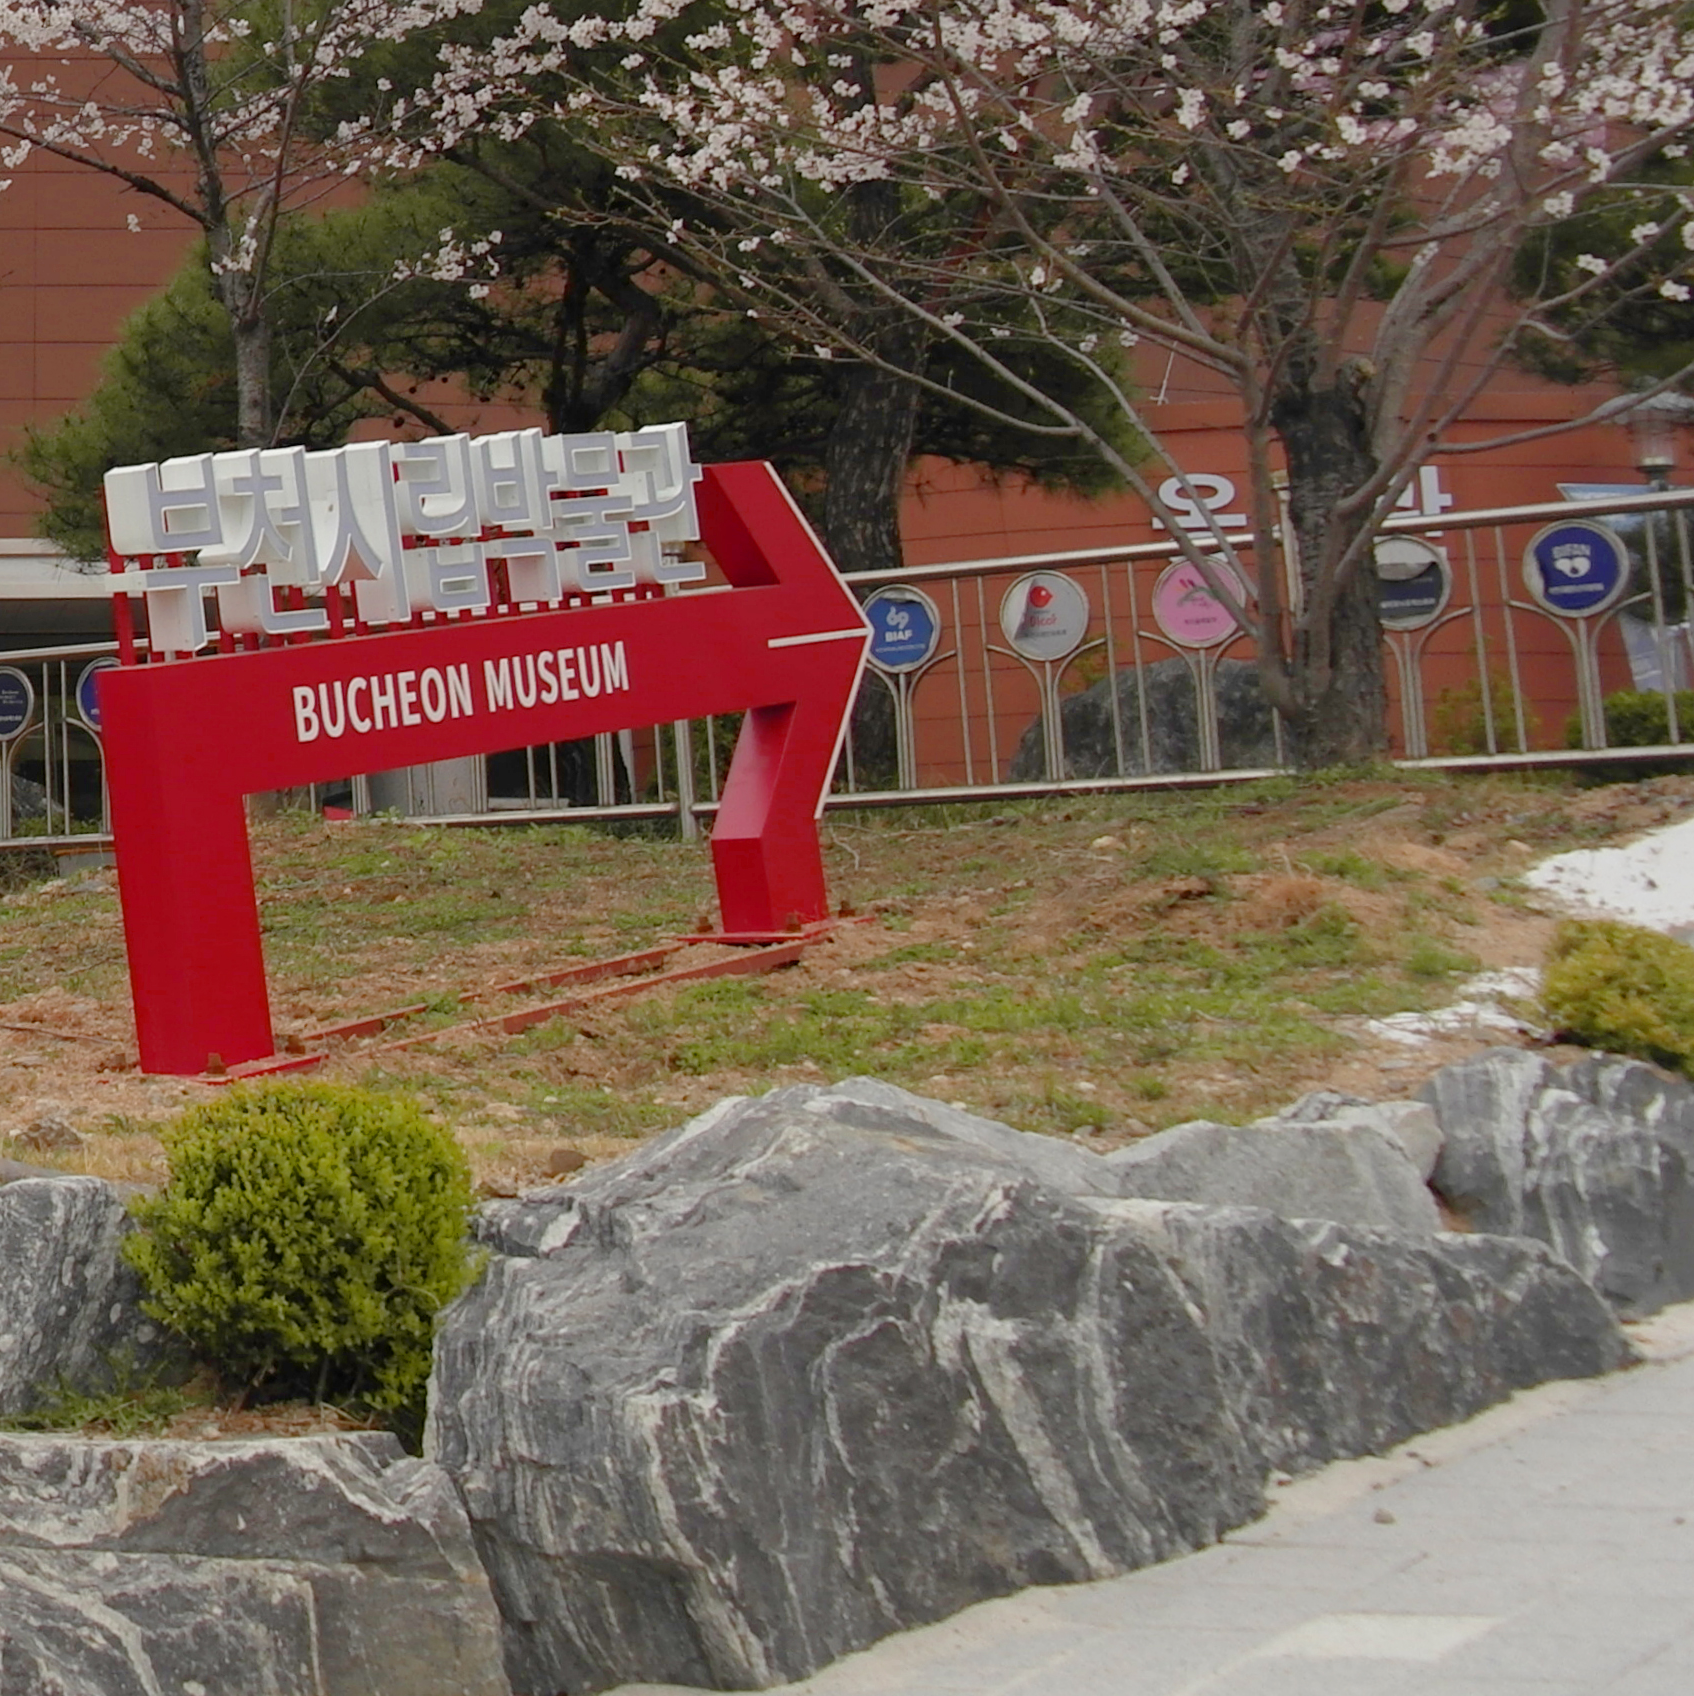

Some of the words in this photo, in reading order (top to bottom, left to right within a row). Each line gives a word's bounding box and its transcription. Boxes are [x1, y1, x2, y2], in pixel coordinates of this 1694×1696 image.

[104, 421, 706, 652] 부천시립박물관
[293, 663, 474, 742] BUCHEON
[483, 640, 629, 713] MUSEUM
